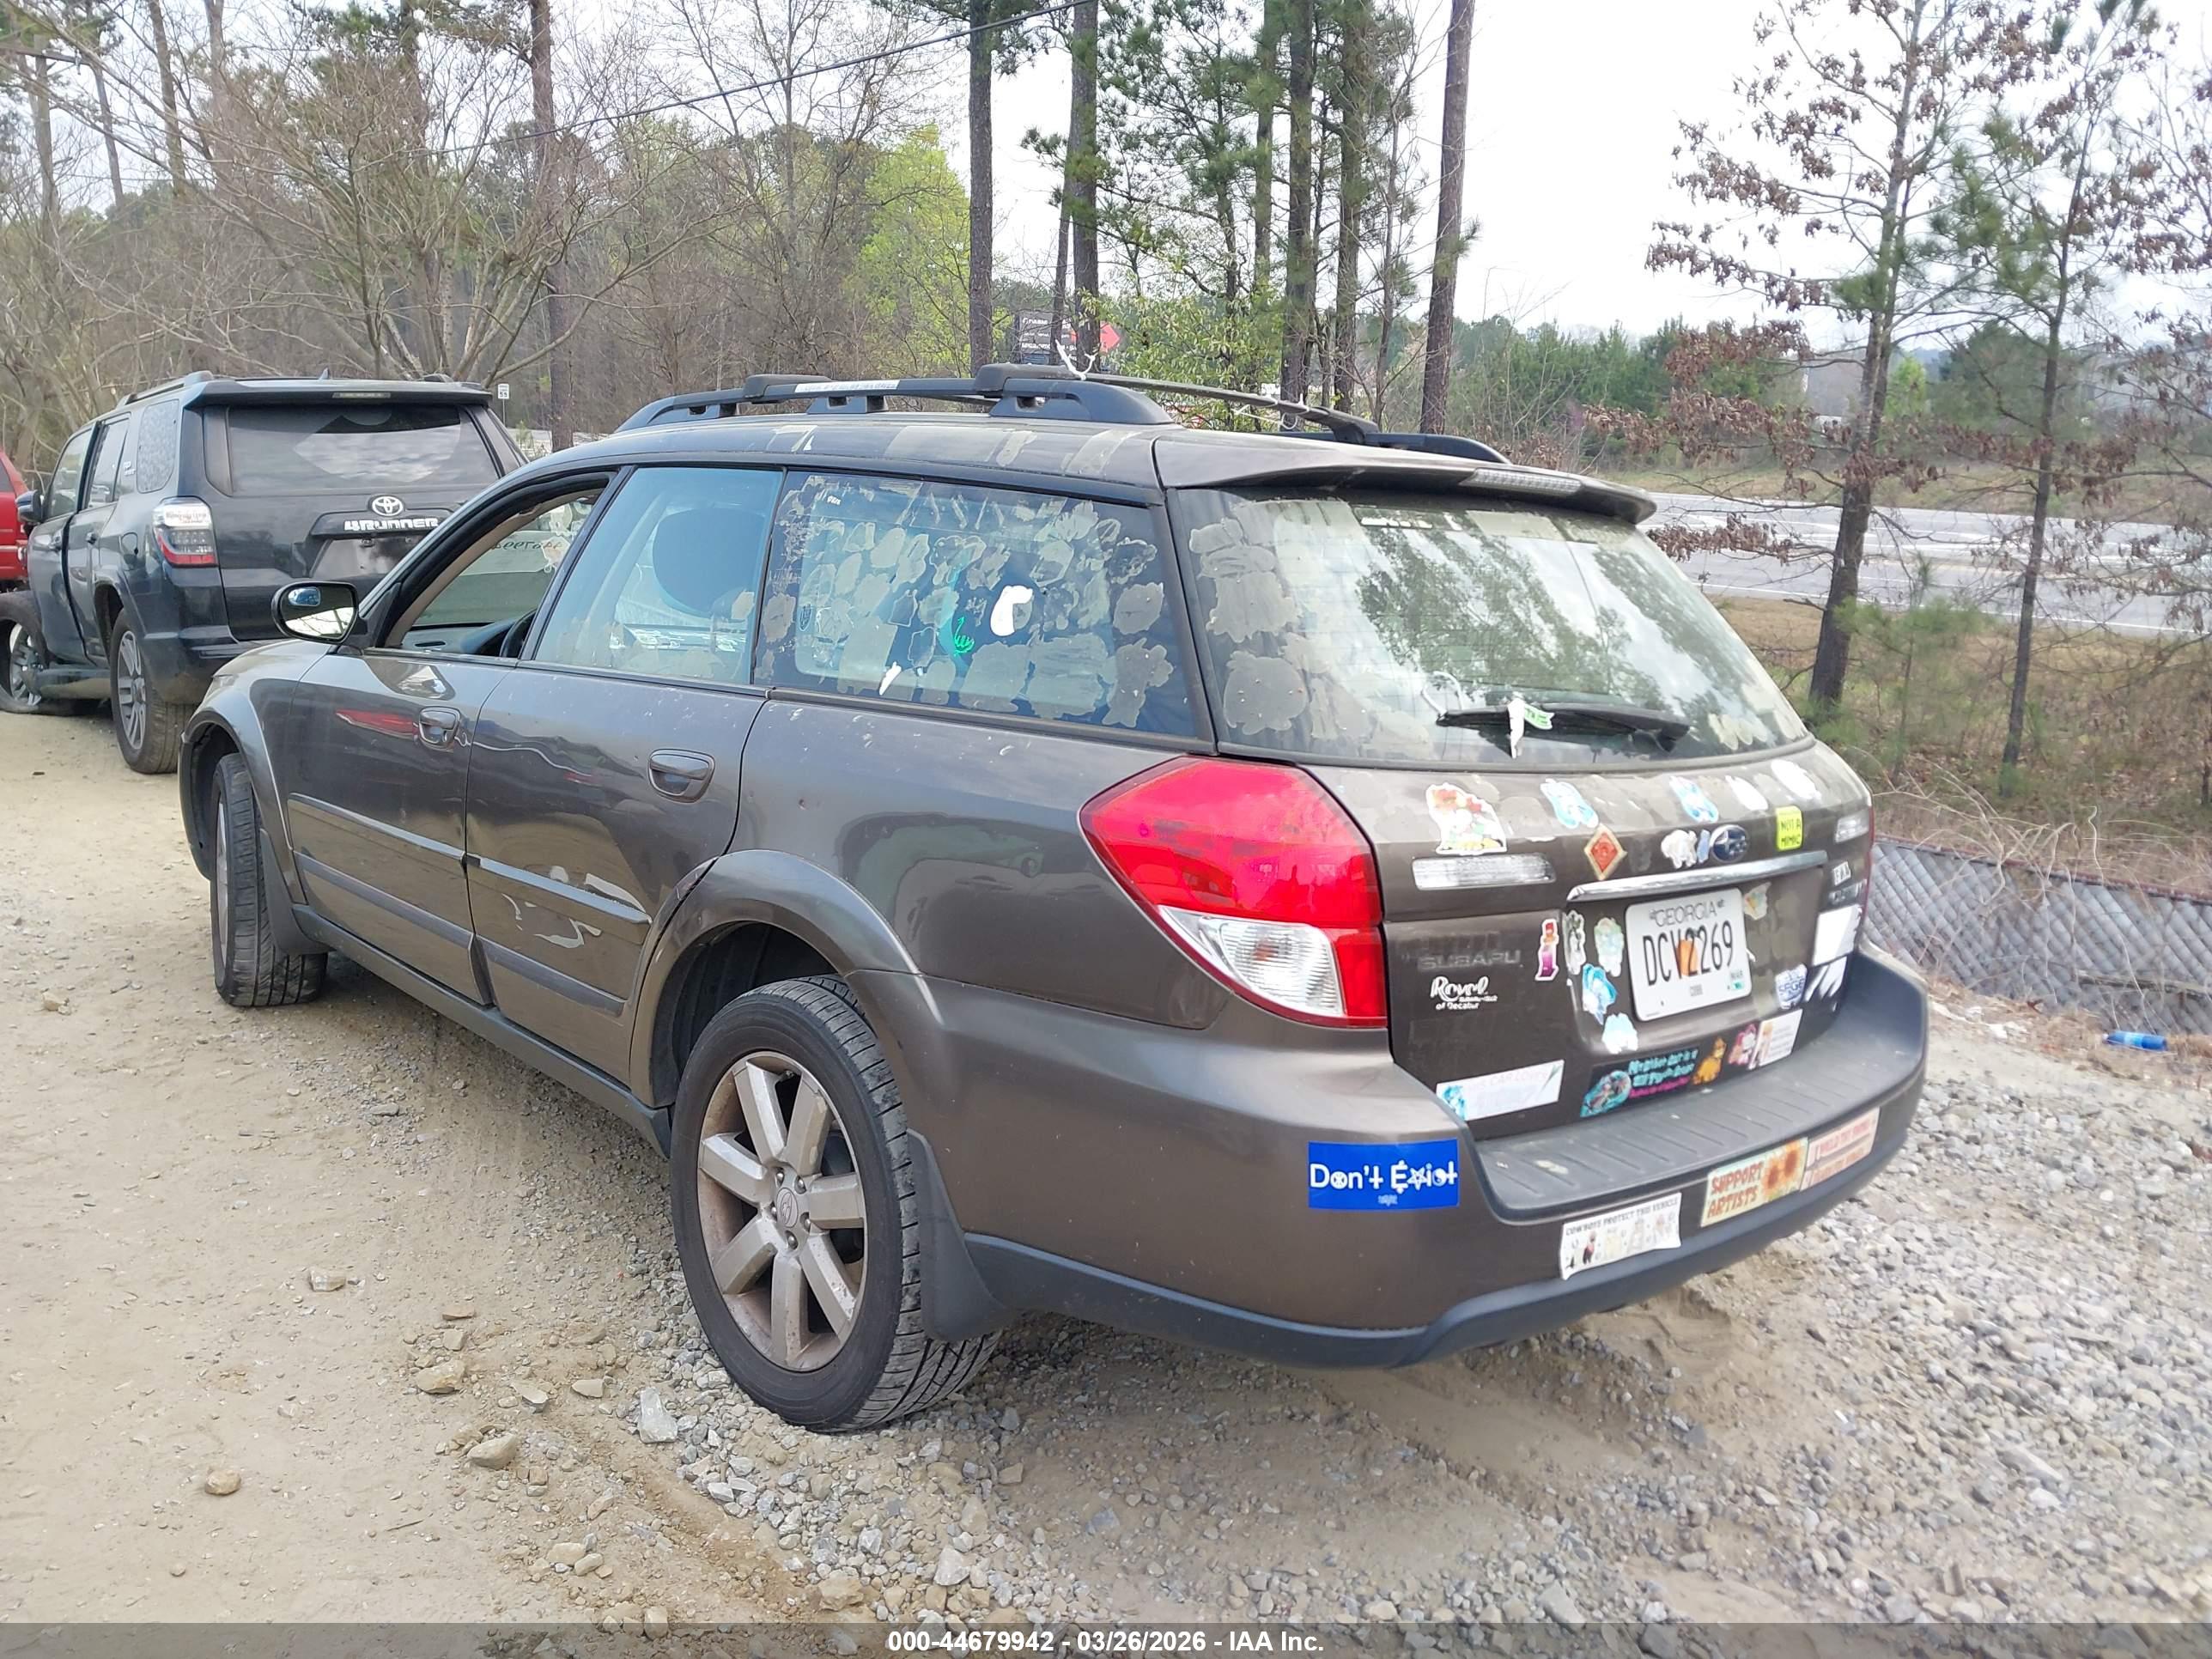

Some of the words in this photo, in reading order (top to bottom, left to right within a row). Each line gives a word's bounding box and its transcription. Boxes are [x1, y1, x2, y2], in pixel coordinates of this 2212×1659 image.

[1655, 902, 1717, 927] GEORGIA
[1643, 920, 1733, 986] DCV2269
[1310, 1163, 1384, 1189] Don't
[1711, 1161, 1763, 1194] SUPPORT
[1603, 1210, 1634, 1225] PROTECT
[1652, 1199, 1679, 1212] VEHICLE
[1707, 1186, 1759, 1218] ARTISTS
